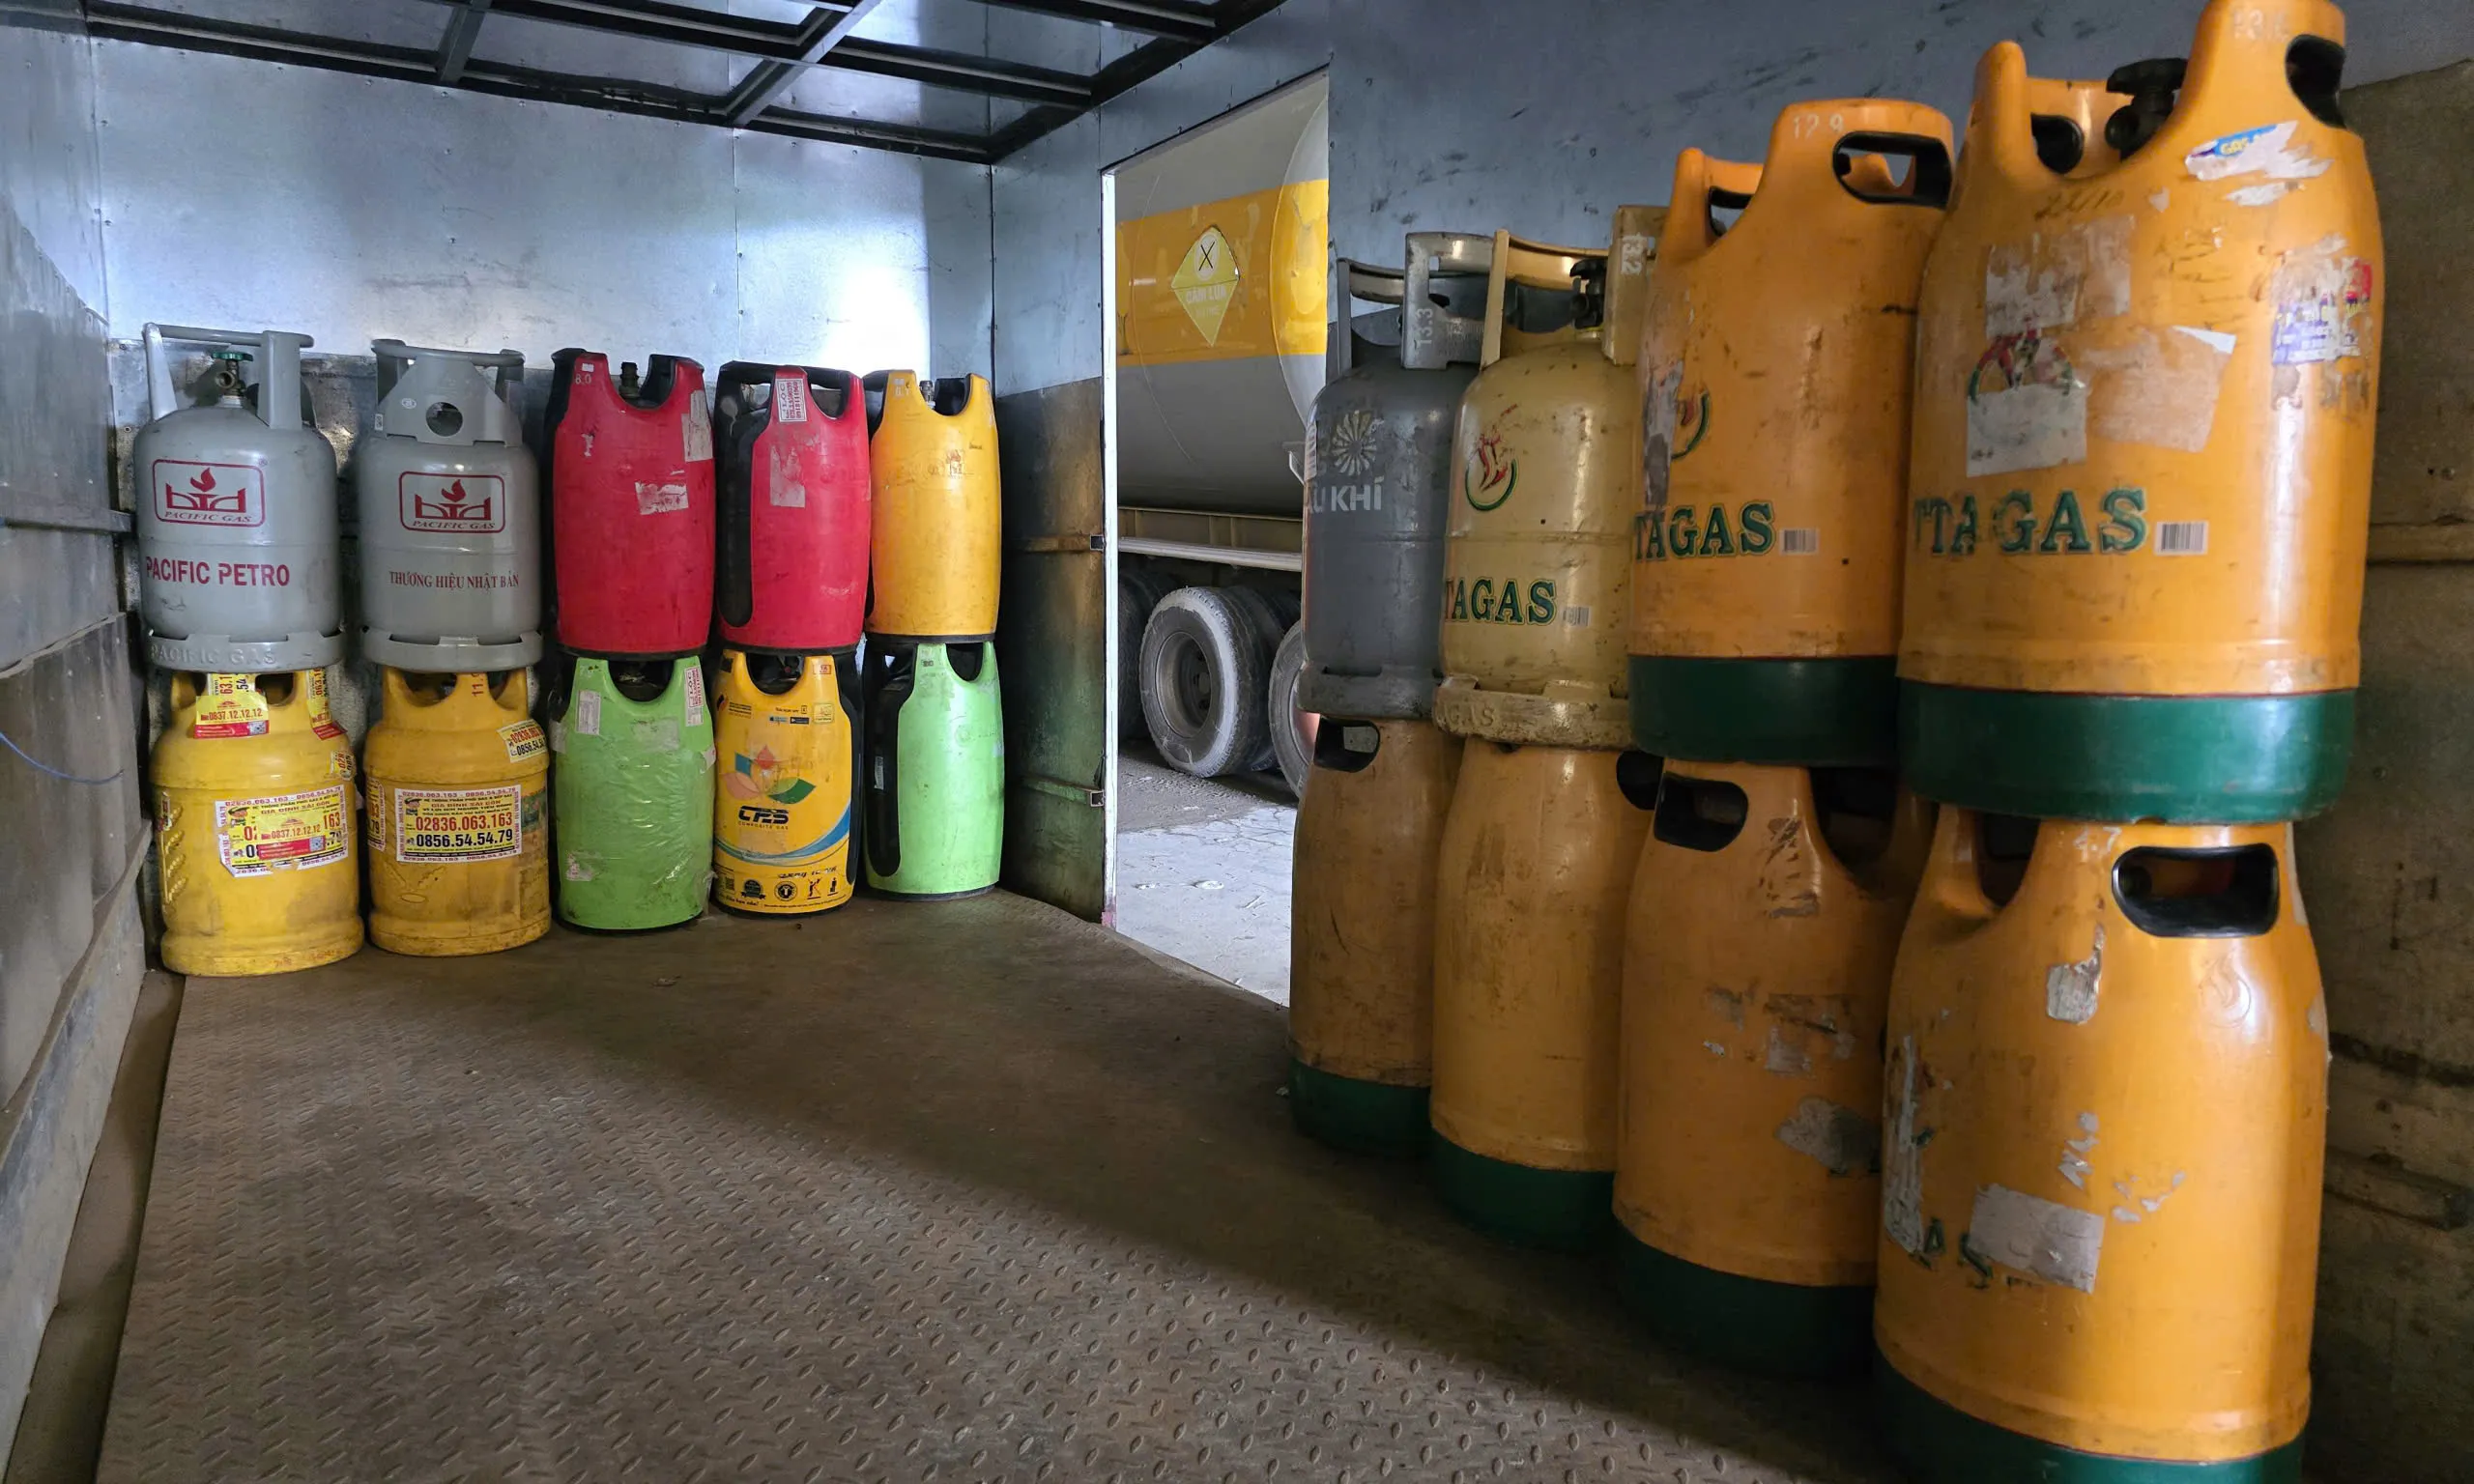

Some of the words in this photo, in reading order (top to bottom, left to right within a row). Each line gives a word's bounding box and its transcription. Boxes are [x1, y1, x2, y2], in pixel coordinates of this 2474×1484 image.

[1331, 475, 1384, 512] KHÍ
[164, 511, 218, 522] PACIFIC
[222, 514, 252, 523] GAS
[413, 520, 468, 529] PACIFIC
[145, 556, 211, 585] PACIFIC
[218, 562, 290, 586] PETRO
[272, 824, 321, 840] 0837.12.12.12
[416, 812, 512, 832] 02836.063.163
[416, 828, 513, 848] 0856.54.54.79
